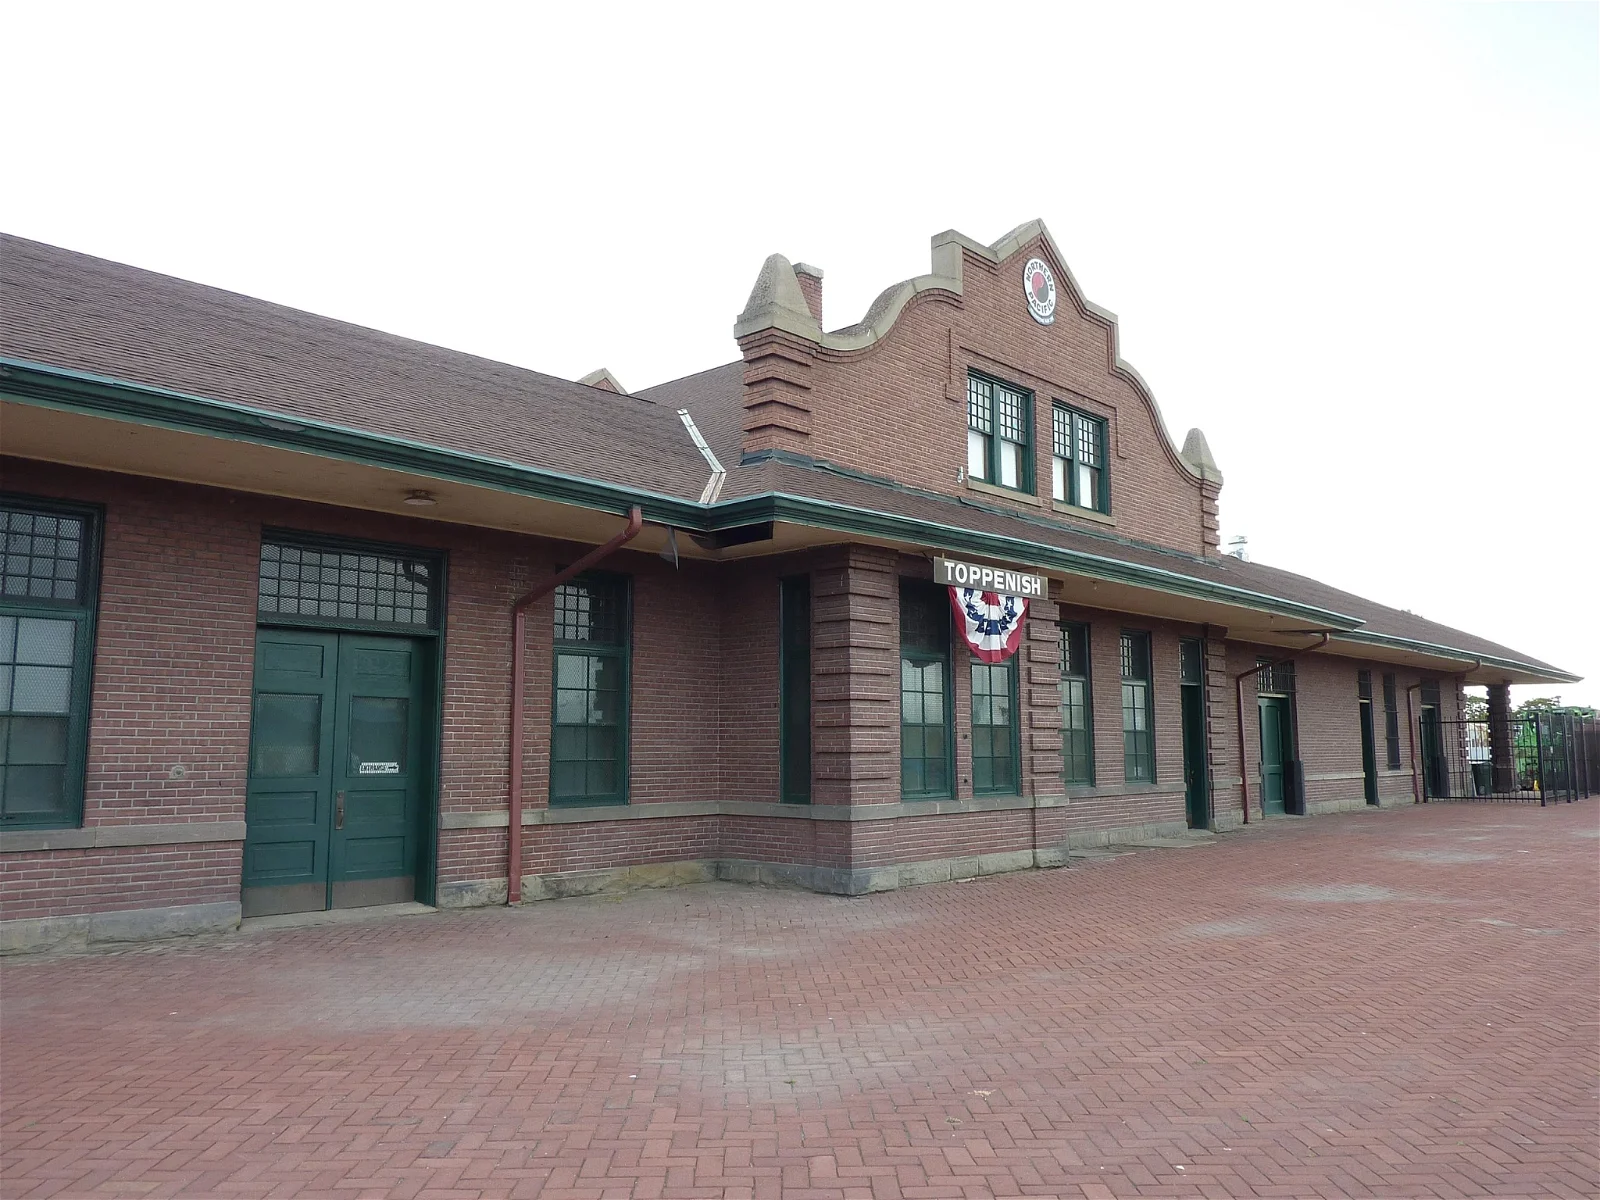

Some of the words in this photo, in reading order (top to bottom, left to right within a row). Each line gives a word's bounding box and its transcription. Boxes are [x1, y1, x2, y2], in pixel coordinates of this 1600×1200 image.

[1026, 261, 1054, 292] NORTHERN
[1028, 291, 1053, 314] PACIFIC
[944, 561, 1041, 595] TOPPENISH
